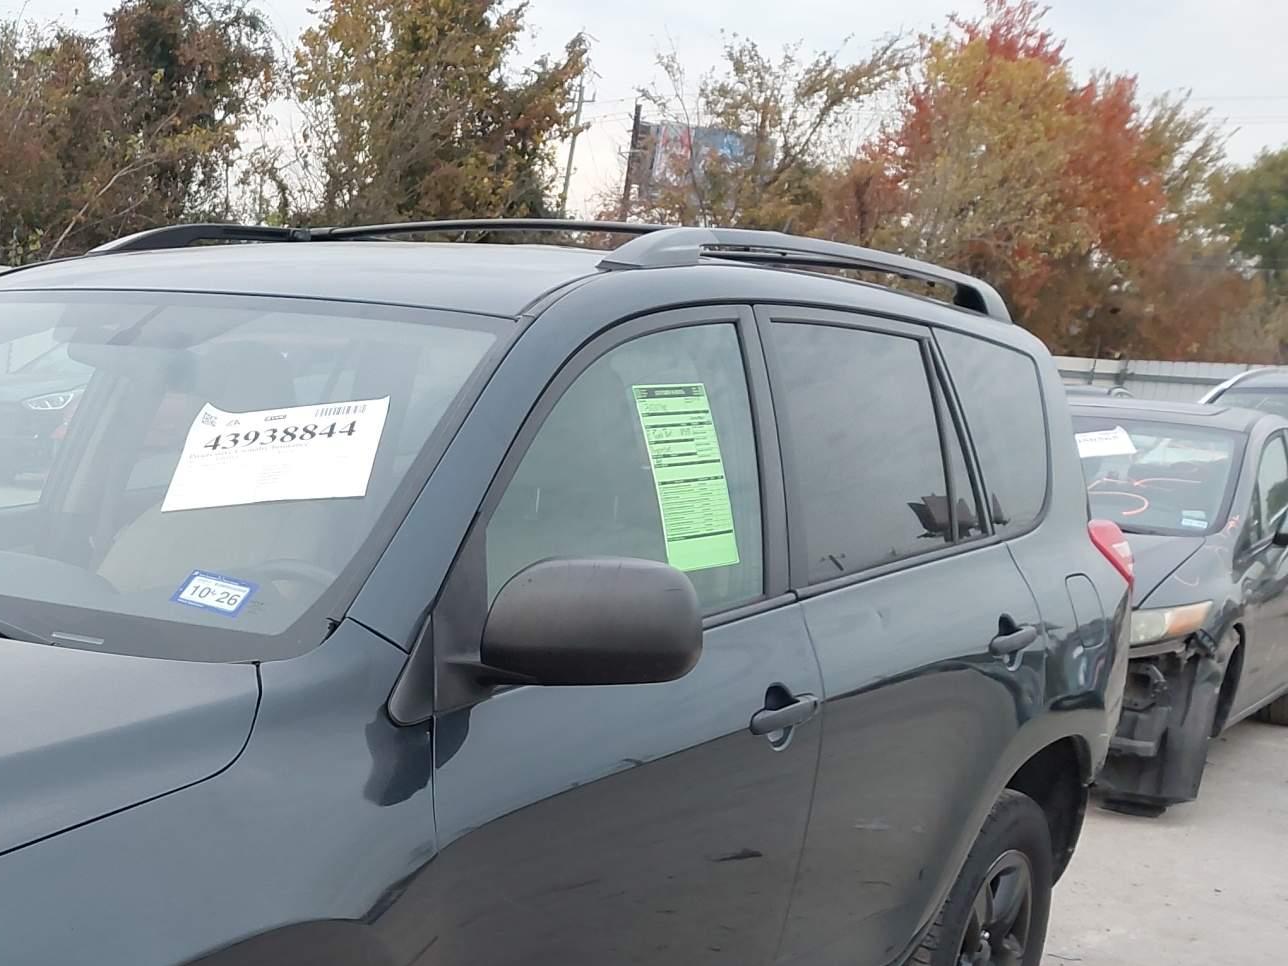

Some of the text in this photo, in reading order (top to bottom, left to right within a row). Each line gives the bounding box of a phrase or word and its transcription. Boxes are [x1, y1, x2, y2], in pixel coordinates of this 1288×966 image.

[203, 420, 357, 451] 43938844
[190, 585, 211, 599] 10
[215, 591, 241, 606] 26
